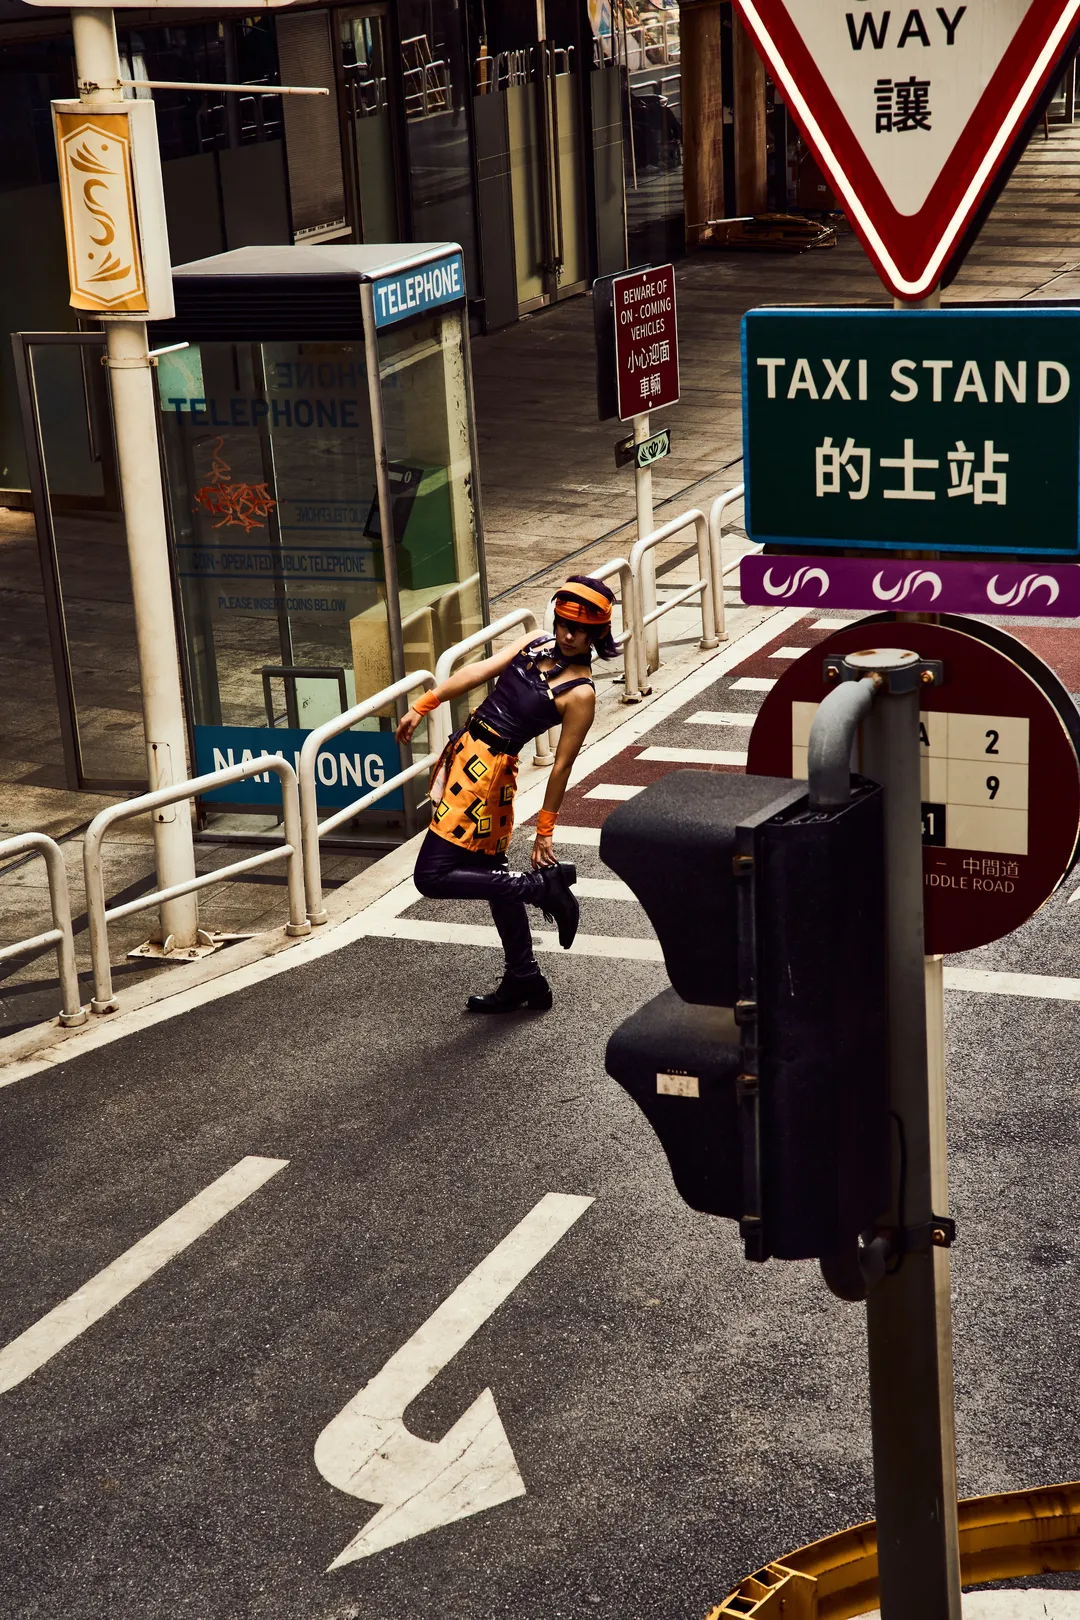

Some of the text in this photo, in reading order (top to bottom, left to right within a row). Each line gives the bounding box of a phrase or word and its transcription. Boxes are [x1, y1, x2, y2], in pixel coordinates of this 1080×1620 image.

[845, 5, 967, 51] WAY
[873, 76, 932, 134] 讓
[377, 262, 460, 317] TELEPHONE
[623, 279, 668, 305] BEWARE OF
[620, 309, 633, 325] ON
[639, 297, 672, 319] COMING
[630, 318, 665, 341] VEHICLES
[627, 340, 670, 374] 小心迎面
[639, 372, 662, 399] 車輛
[756, 357, 1071, 404] TAXI STAND
[167, 397, 360, 429] TELEPHONE
[815, 435, 1010, 506] 的士站
[273, 553, 308, 572] PUBLIC
[309, 555, 366, 574] TELEPHONE
[218, 596, 346, 613] PLEASE INSERT COINS BELOW
[984, 729, 999, 755] 2
[986, 775, 1000, 800] 9
[962, 857, 1020, 879] 中間道
[925, 873, 1015, 894] IDDLE ROAD
